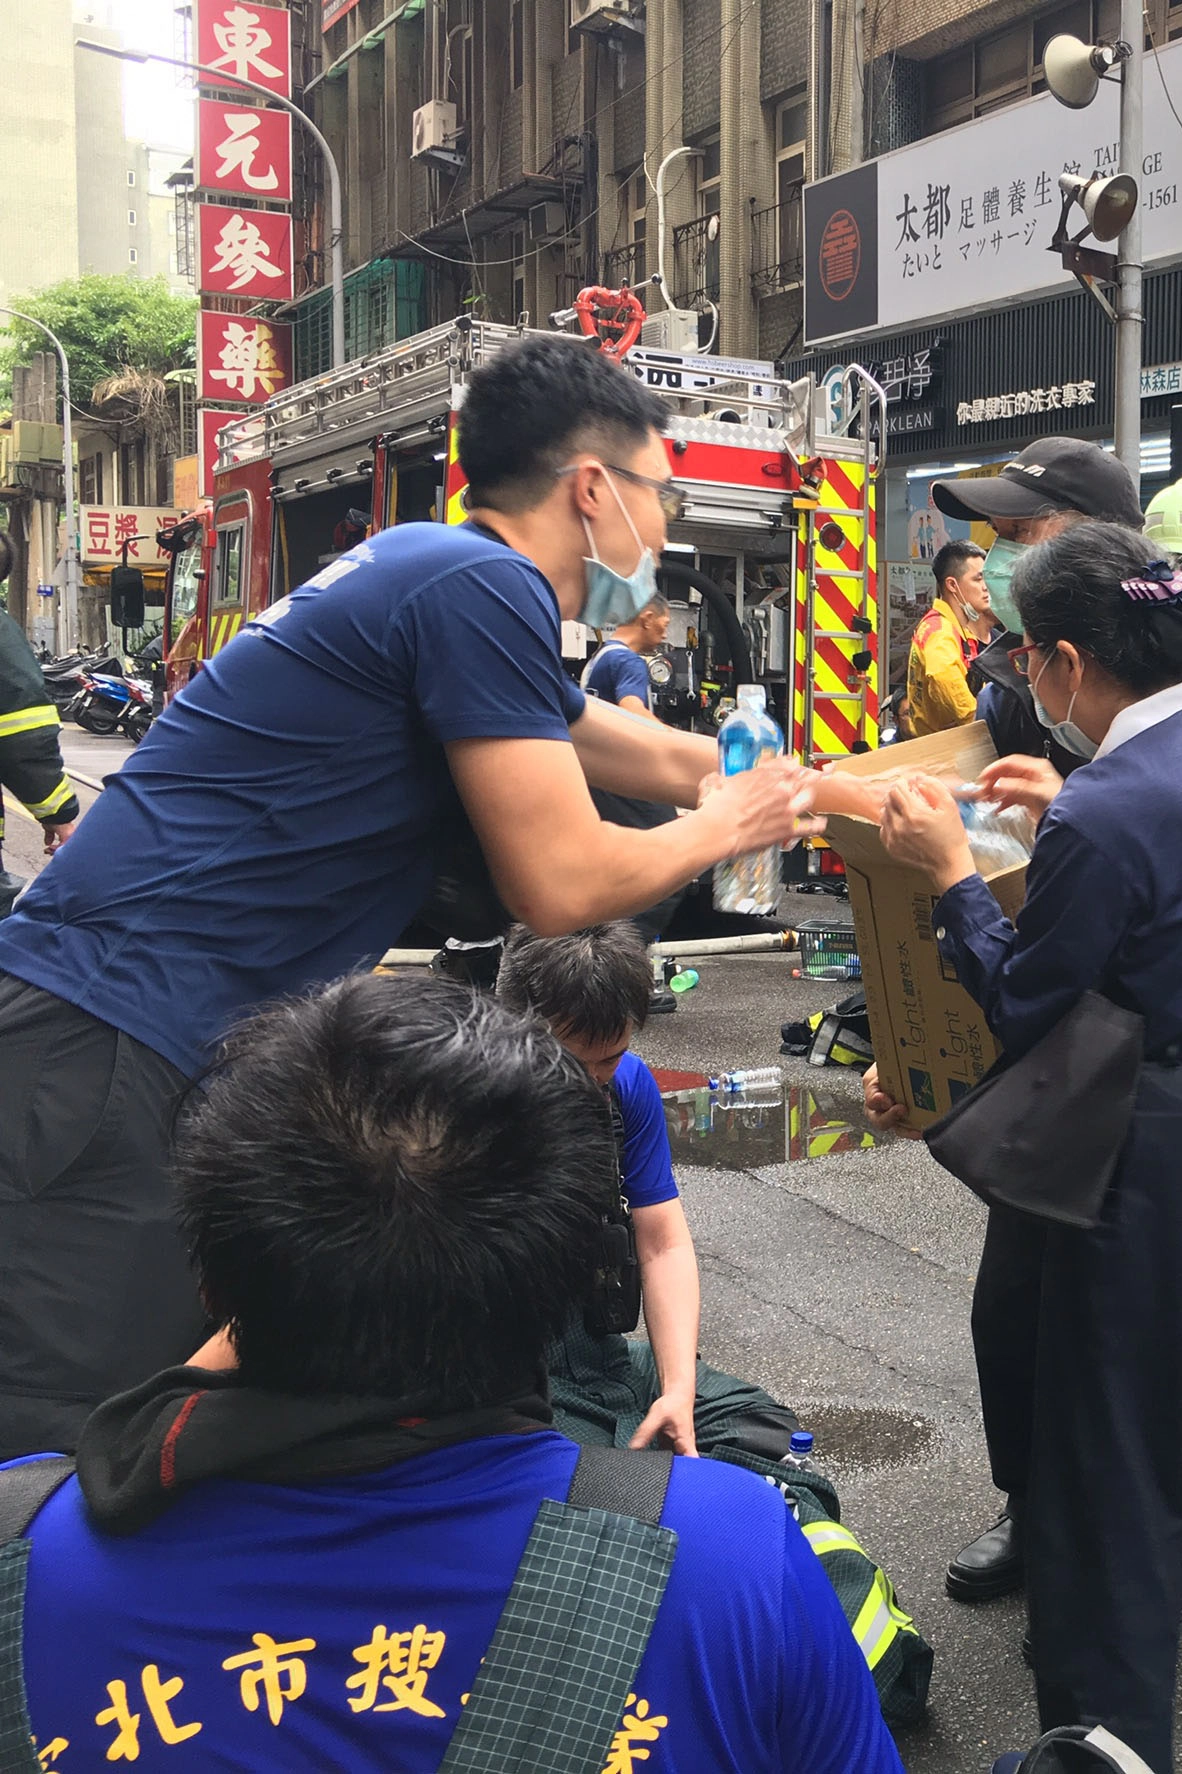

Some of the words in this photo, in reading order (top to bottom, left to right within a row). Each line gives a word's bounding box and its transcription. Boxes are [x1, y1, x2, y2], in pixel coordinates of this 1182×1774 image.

[903, 244, 942, 279] たいと
[956, 380, 1096, 426] 你最親近的洗衣專家
